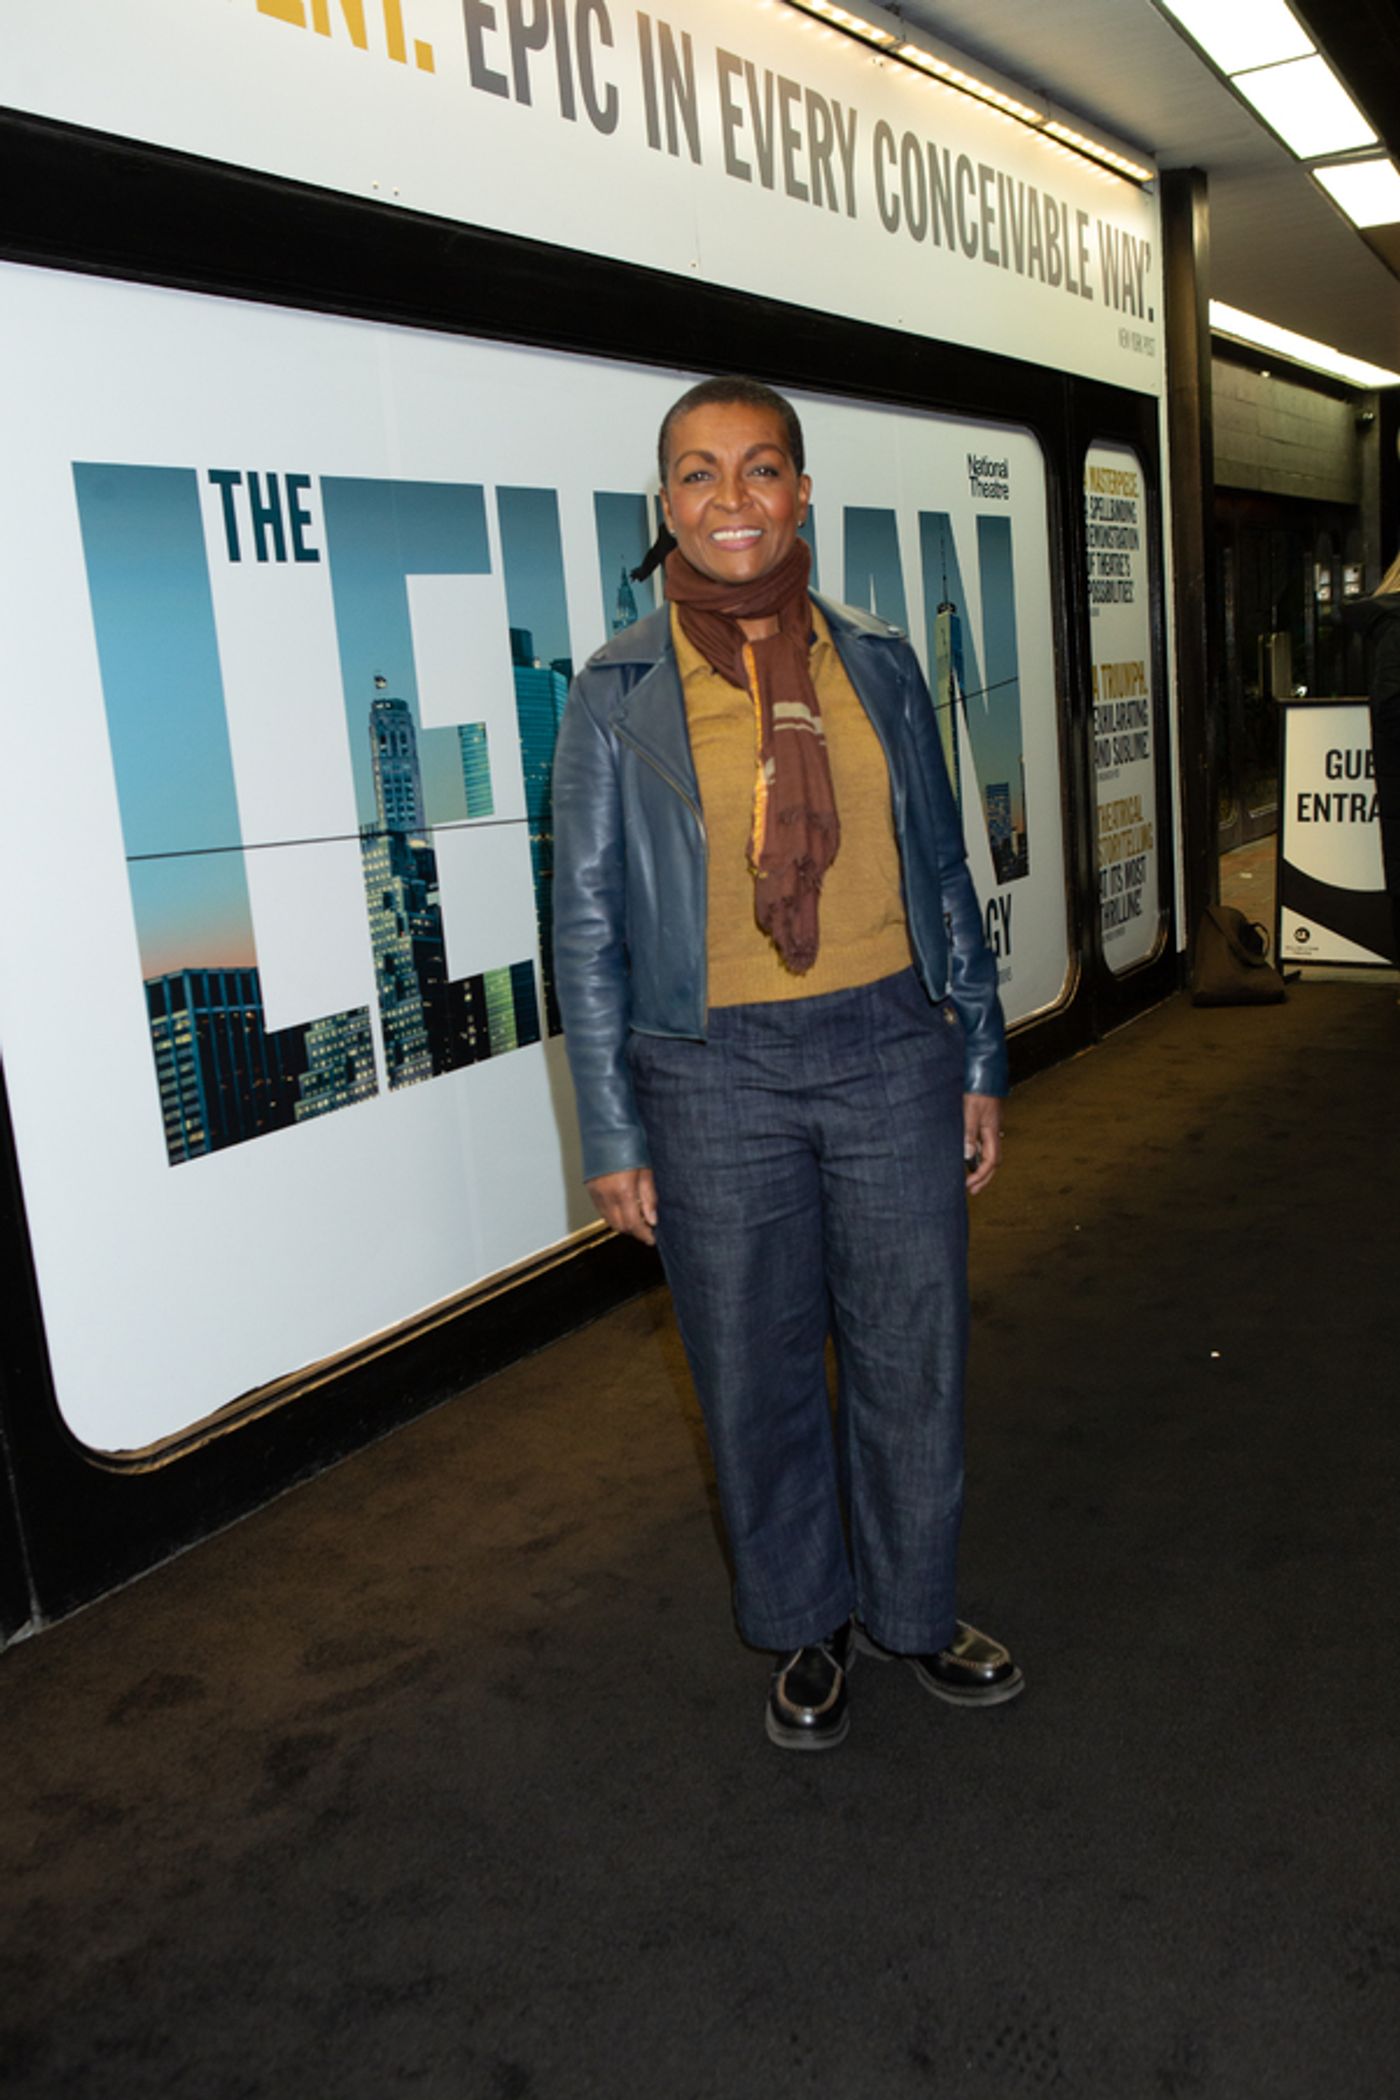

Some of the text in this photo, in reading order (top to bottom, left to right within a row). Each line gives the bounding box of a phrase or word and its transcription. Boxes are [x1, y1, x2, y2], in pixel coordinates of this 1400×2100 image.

[462, 0, 619, 135] EPIC
[636, 10, 703, 166] IN
[716, 47, 858, 219] EVERY
[873, 118, 1094, 301] CONCEIVABLE
[967, 453, 1009, 479] National
[969, 476, 1009, 500] Theatre
[207, 469, 321, 563] THE
[1325, 748, 1377, 780] GUE
[1297, 793, 1381, 823] ENTRA
